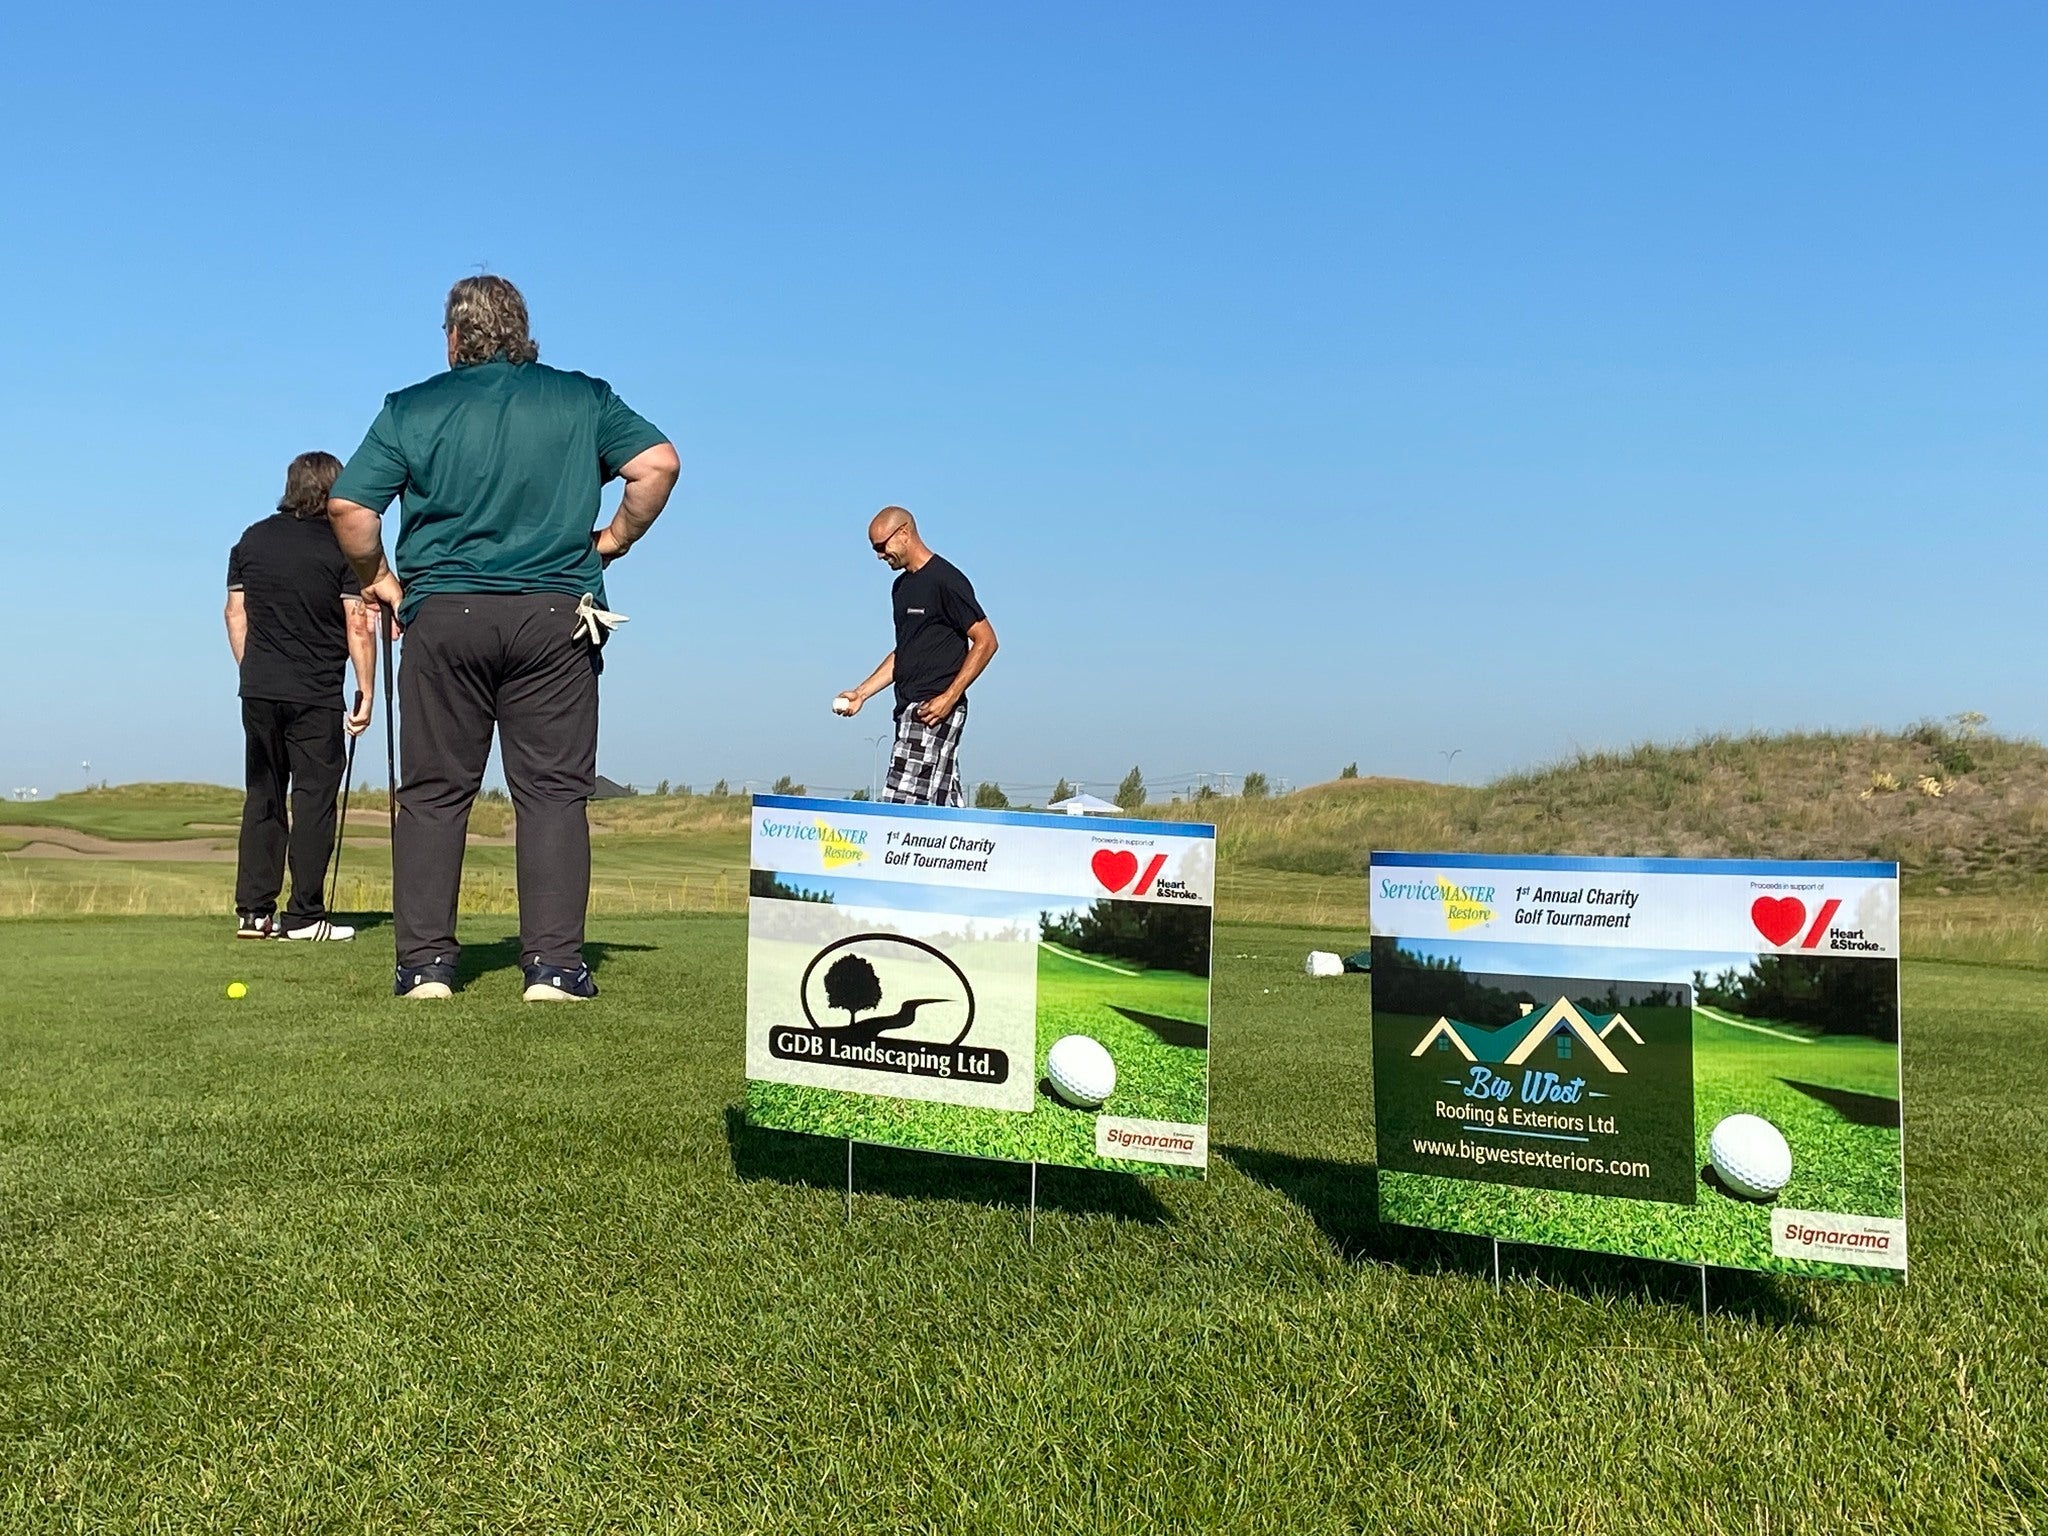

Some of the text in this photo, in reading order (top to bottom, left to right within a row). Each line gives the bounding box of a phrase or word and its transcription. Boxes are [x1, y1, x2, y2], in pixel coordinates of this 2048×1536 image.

[760, 818, 868, 845] ServiceMASTER
[823, 845, 863, 861] Restore
[886, 831, 996, 856] 1st Annual Charity
[884, 850, 988, 872] Golf Tournament
[1156, 878, 1185, 890] Heart
[1156, 888, 1197, 900] &Stroke
[1380, 878, 1495, 903] ServiceMASTER
[1750, 881, 1781, 890] Proceeds
[1515, 886, 1639, 908] 1st Annual Charity
[1448, 904, 1491, 921] Restore
[1515, 908, 1631, 928] Golf Tournament
[1830, 928, 1863, 940] Heart
[1830, 940, 1879, 951] &Stroke
[777, 1032, 995, 1077] GDB Landscaping Ltd.
[1463, 1066, 1586, 1105] Big West
[1436, 1100, 1620, 1135] Roofing & Exteriors Ltd.
[1107, 1129, 1194, 1150] Signarama
[1413, 1138, 1650, 1178] www.bigwestexteriors.com
[1785, 1224, 1890, 1249] Signarama
